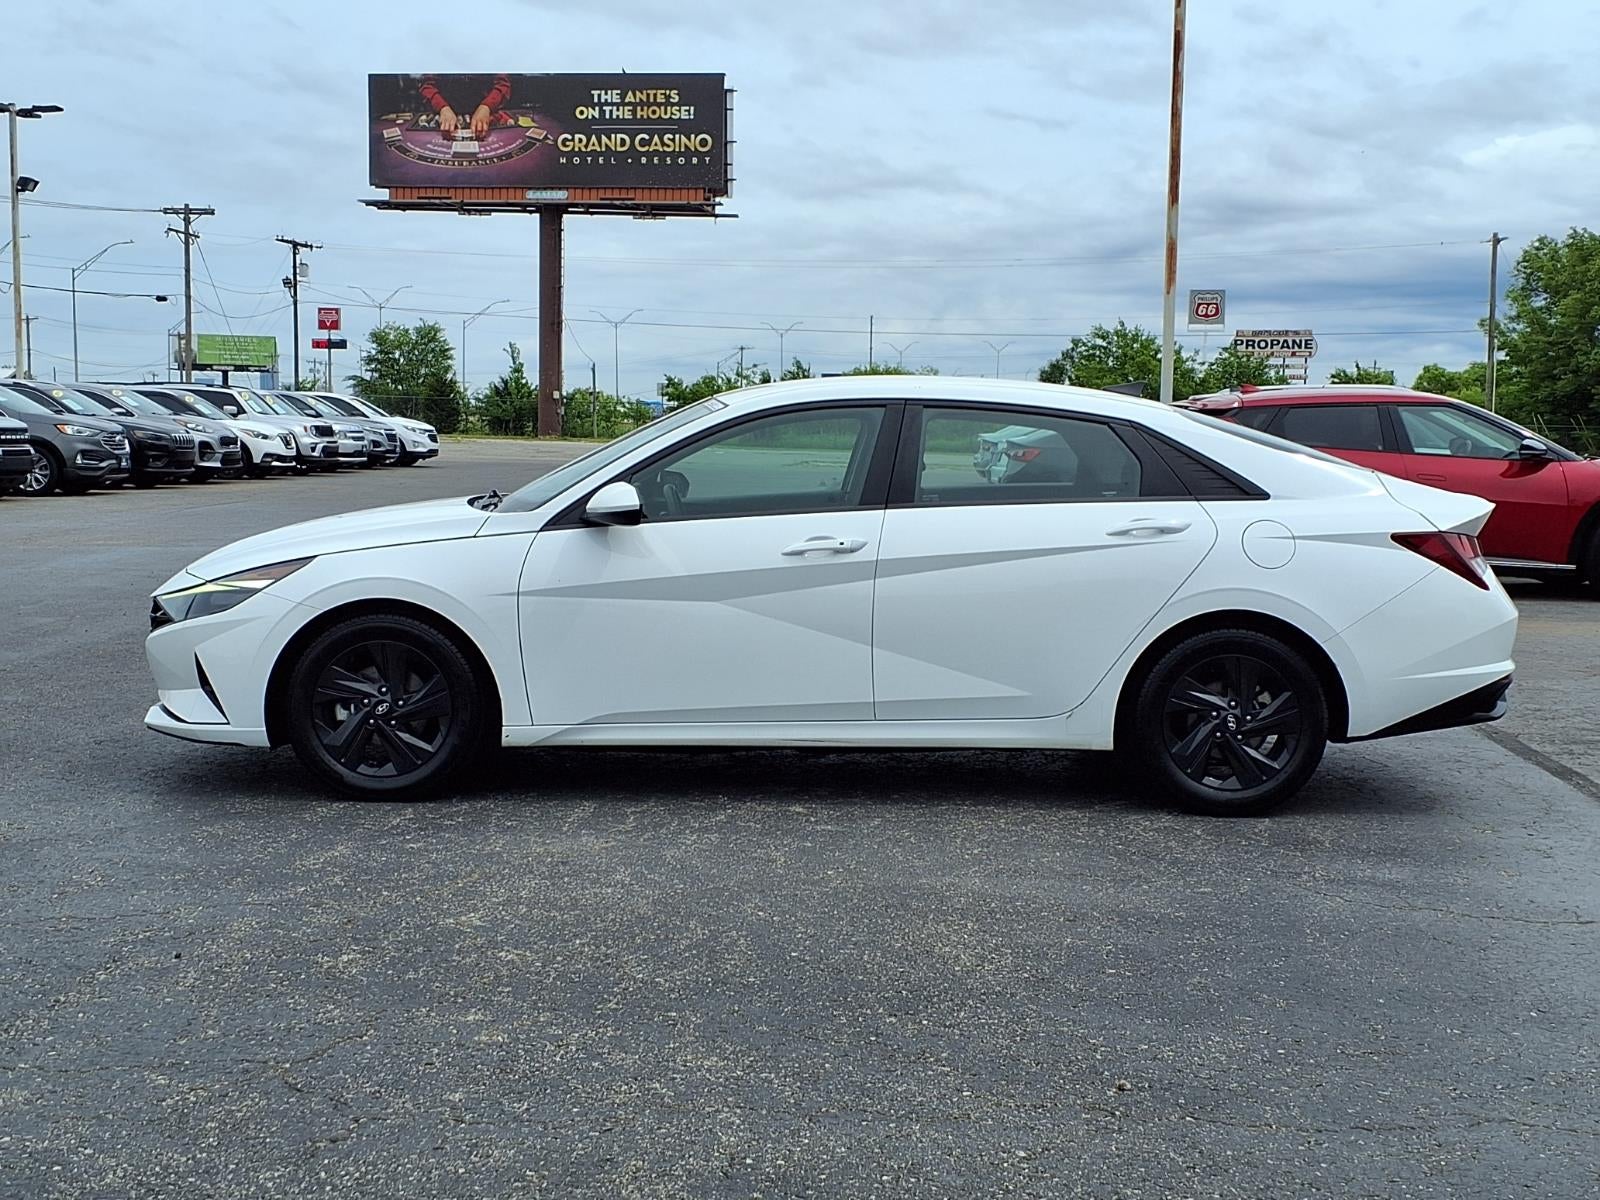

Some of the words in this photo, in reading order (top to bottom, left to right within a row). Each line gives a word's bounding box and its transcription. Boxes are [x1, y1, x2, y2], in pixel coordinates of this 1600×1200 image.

[591, 90, 620, 102] THE
[624, 89, 680, 103] ANTE'S
[575, 106, 599, 119] ON
[603, 106, 632, 119] THE
[636, 106, 695, 119] HOUSE!
[557, 133, 631, 152] GRAND
[634, 133, 713, 152] CASINO
[560, 157, 616, 165] HOTEL
[641, 157, 711, 165] RESORT
[1197, 304, 1217, 316] 66
[1234, 339, 1313, 350] PROPANE
